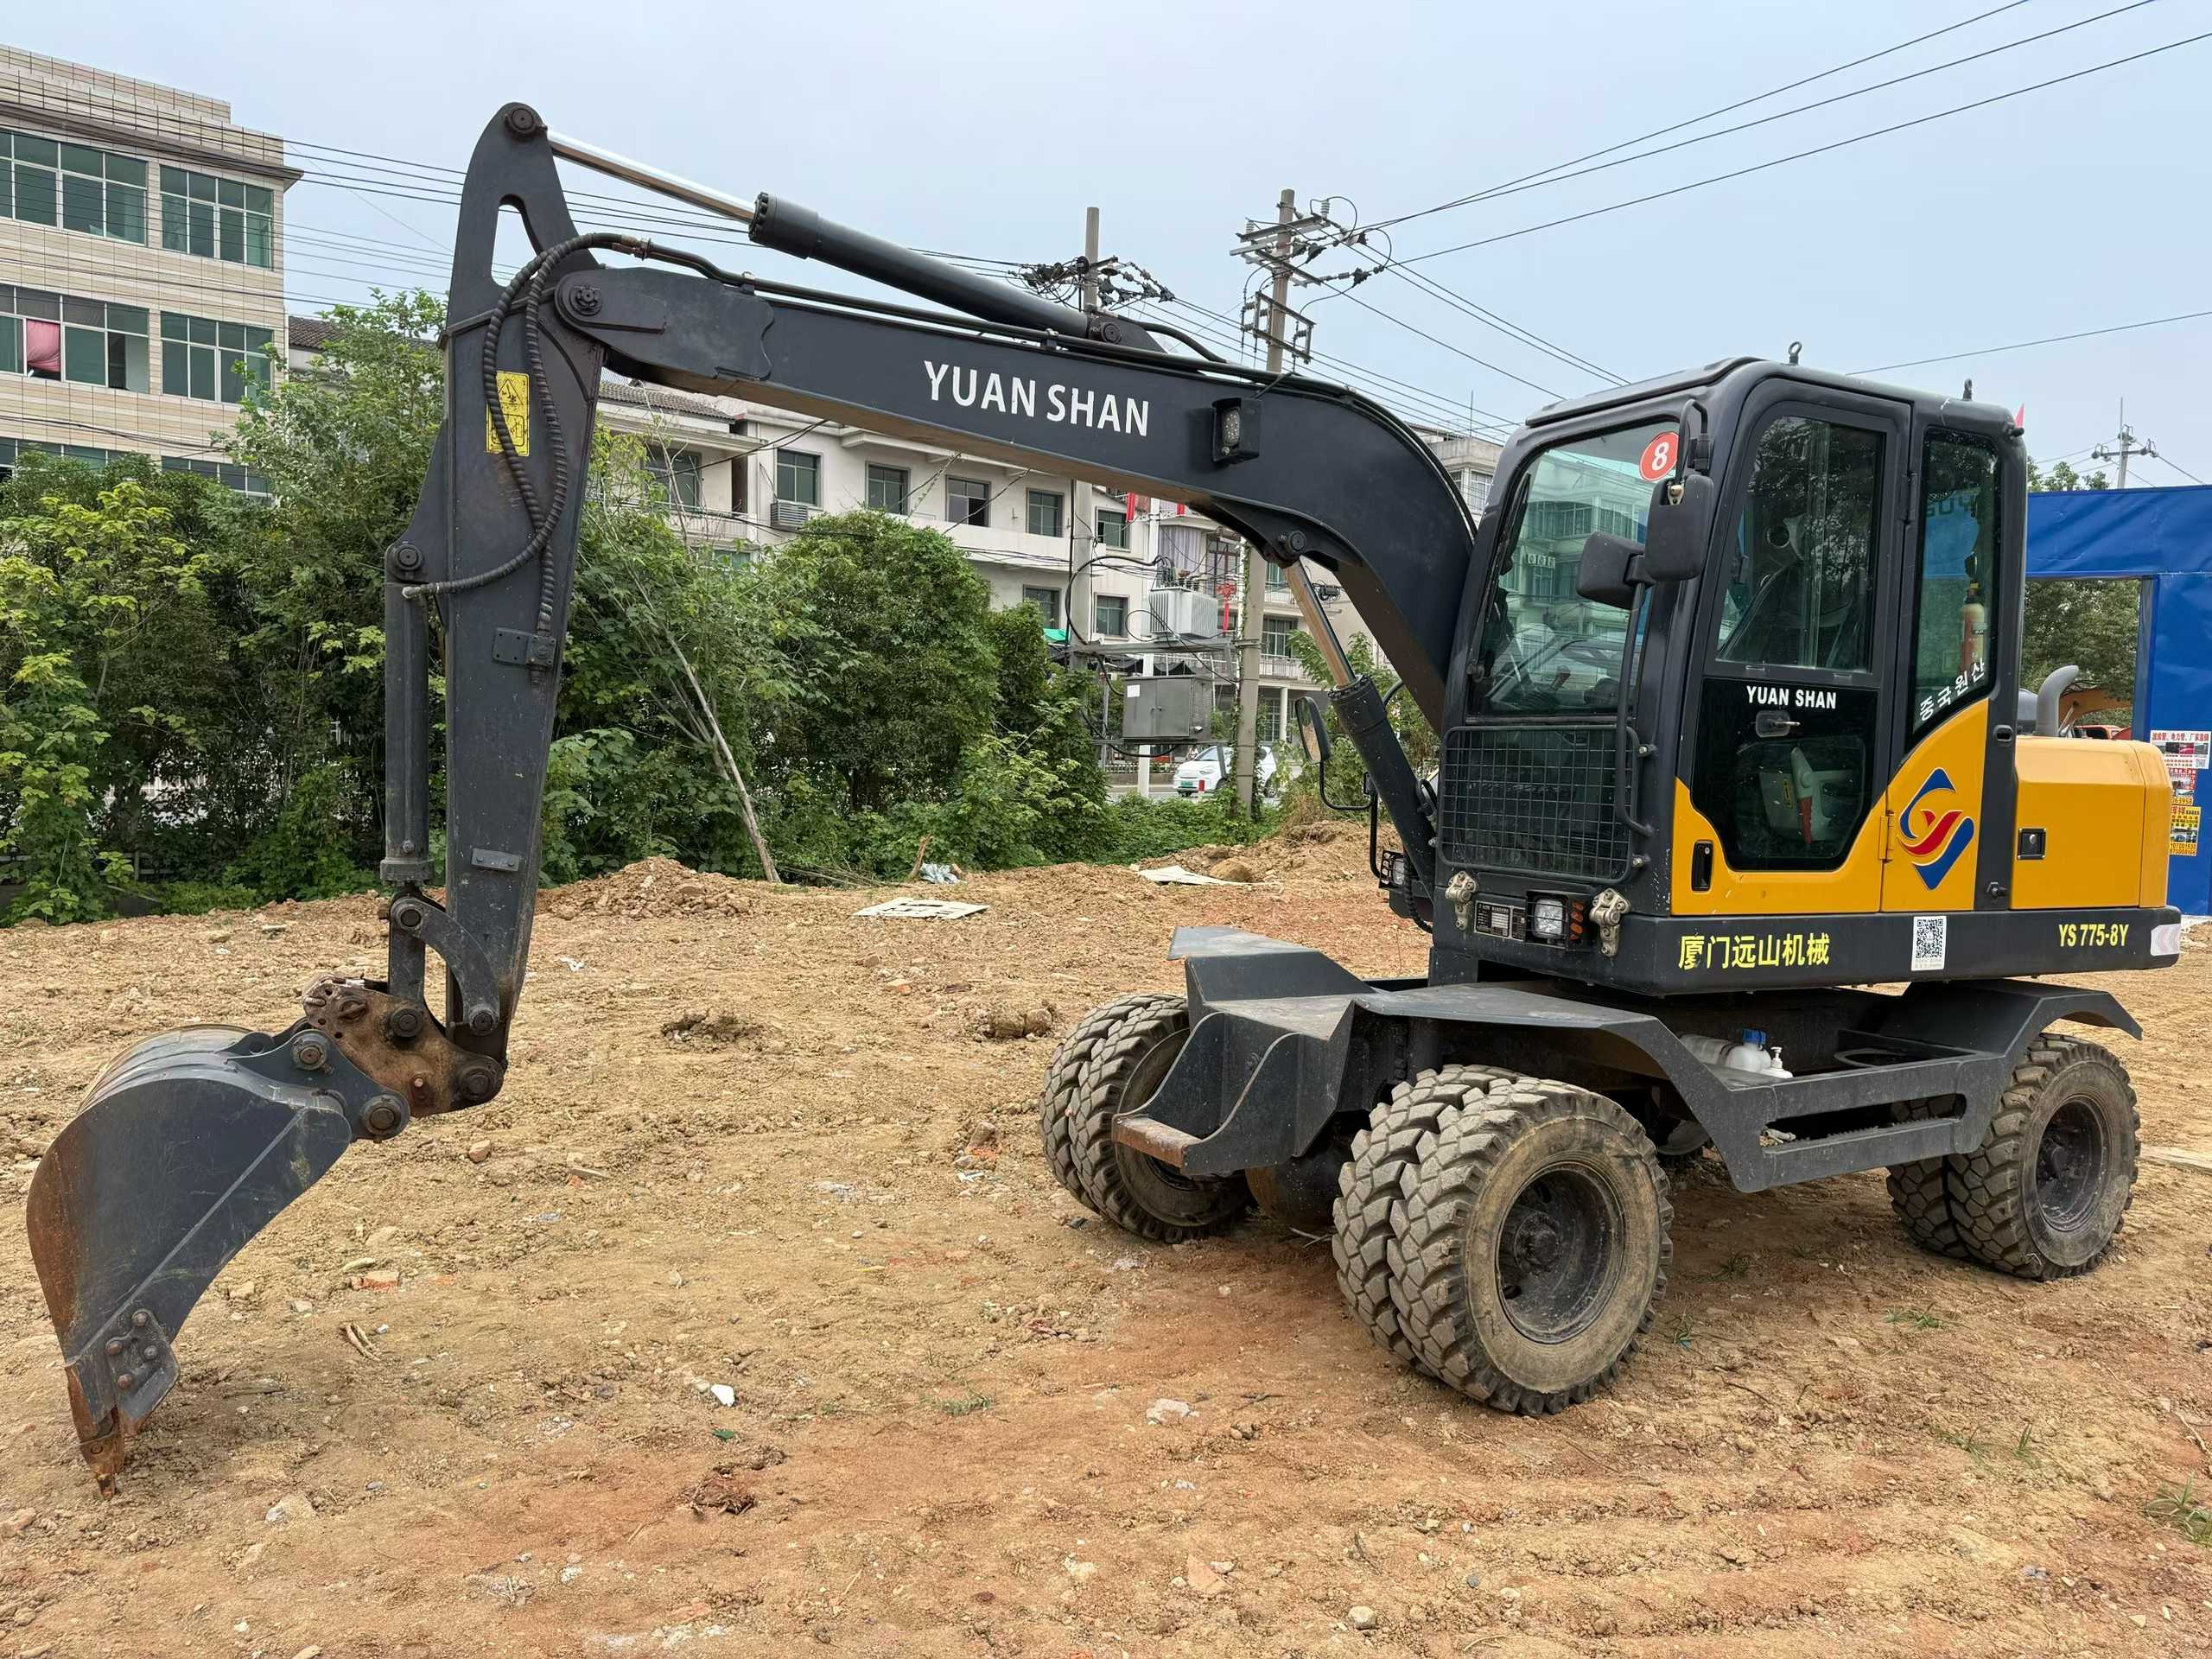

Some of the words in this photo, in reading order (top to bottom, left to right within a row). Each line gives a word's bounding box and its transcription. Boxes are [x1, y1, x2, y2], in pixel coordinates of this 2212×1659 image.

[924, 360, 1036, 417] YUAN
[1046, 385, 1149, 436] SHAN
[1651, 442, 1669, 471] 8
[1746, 685, 1789, 706] YUAN
[1795, 689, 1837, 709] SHAN
[1919, 657, 1985, 721] 중국원산
[1678, 932, 1830, 970] 厦门远山机械
